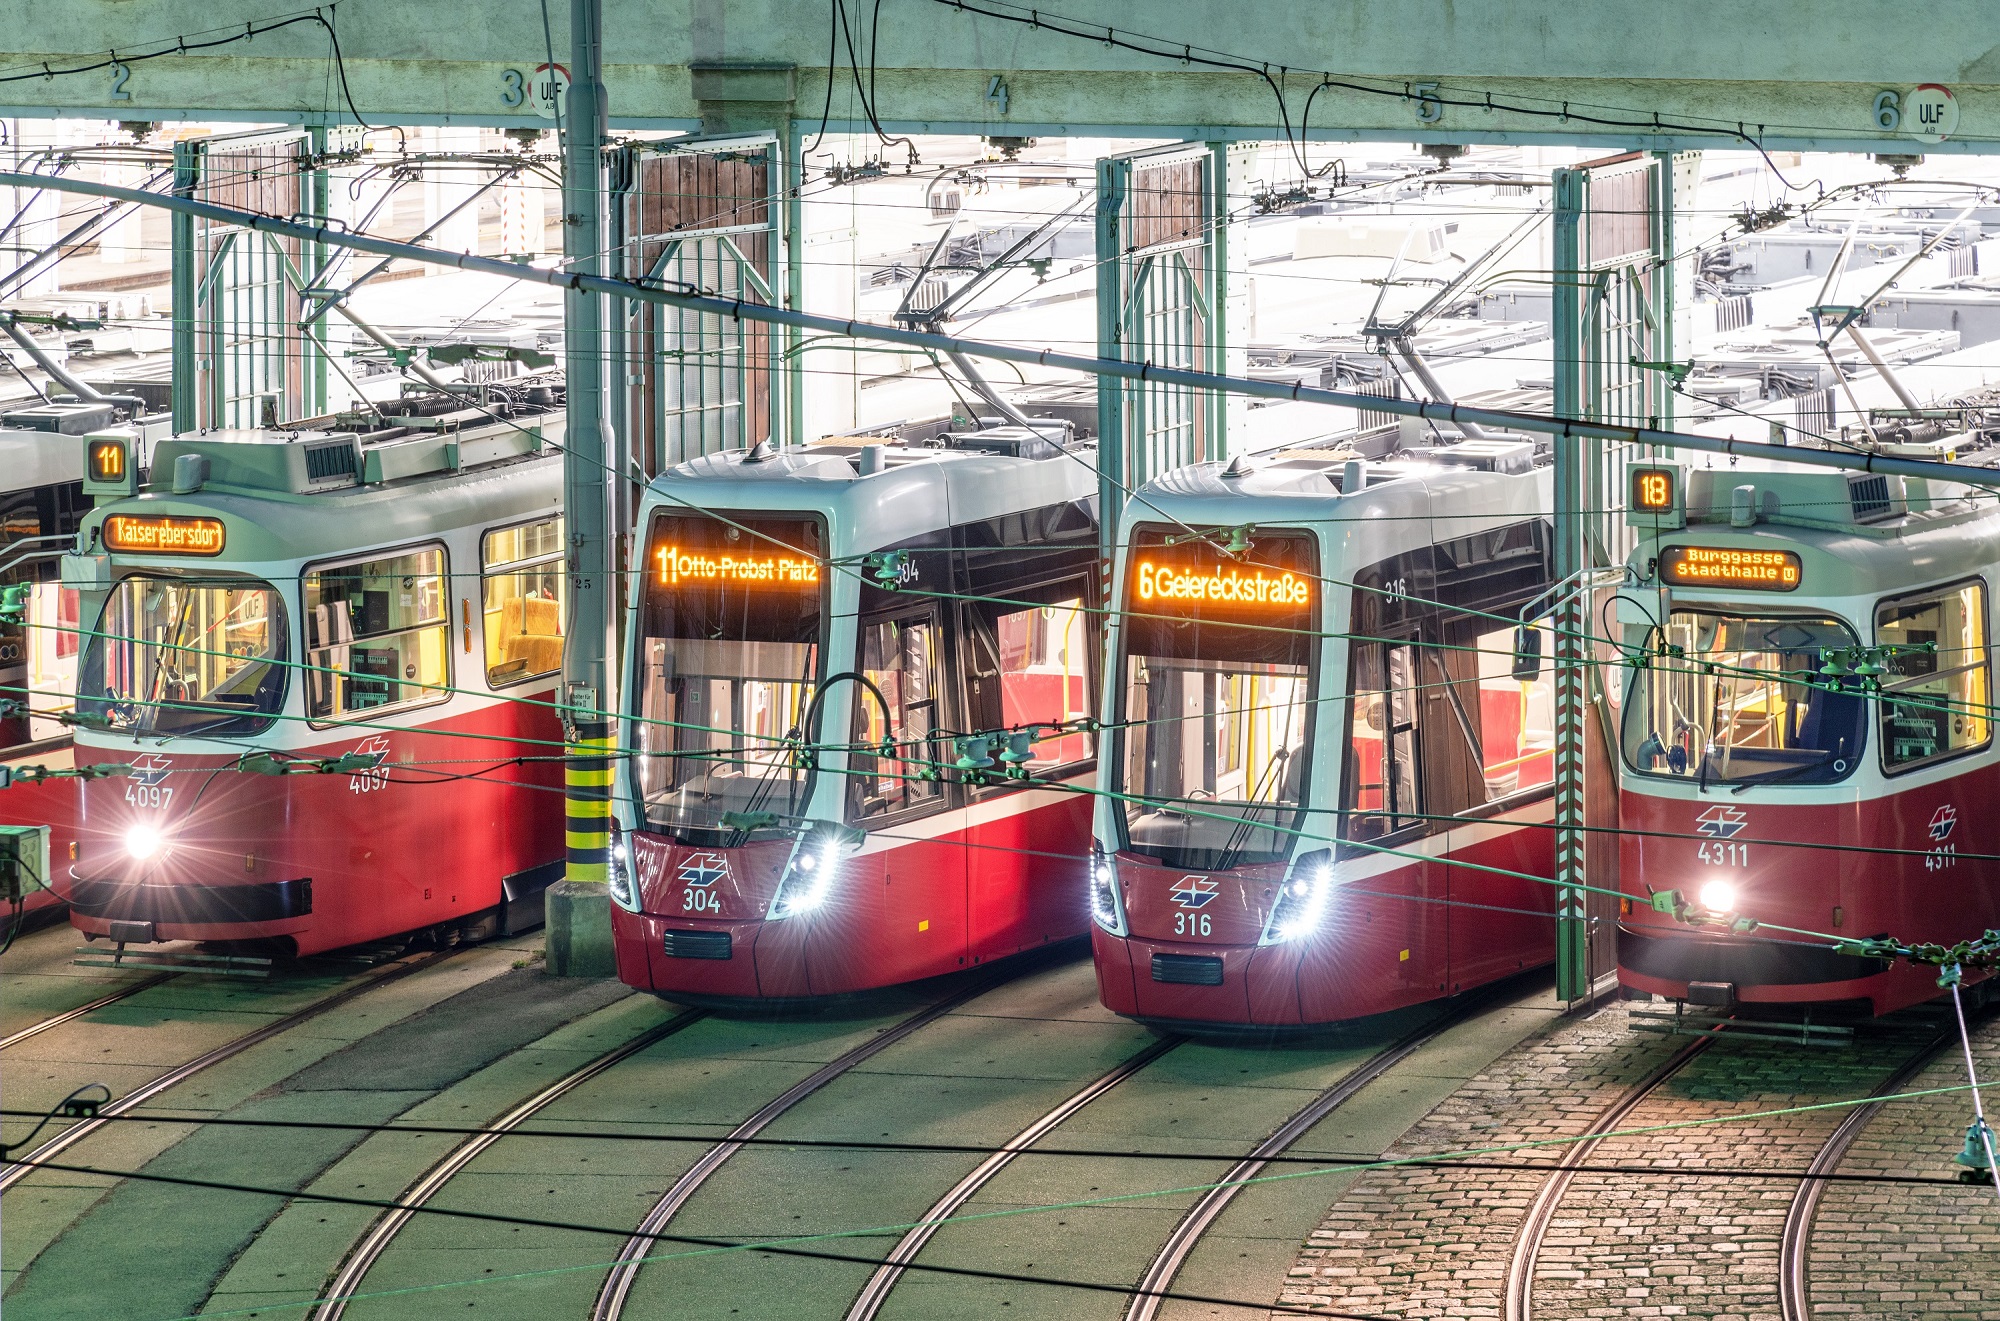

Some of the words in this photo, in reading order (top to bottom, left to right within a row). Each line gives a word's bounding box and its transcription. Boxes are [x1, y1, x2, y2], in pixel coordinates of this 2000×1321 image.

[109, 63, 130, 100] 2
[501, 69, 524, 108] 3
[541, 82, 562, 100] ULF
[986, 75, 1009, 114] 4
[1416, 82, 1442, 123] 5
[1873, 90, 1900, 131] 6
[1919, 104, 1944, 124] ULF
[98, 446, 119, 473] 11
[1641, 475, 1666, 505] 18
[117, 516, 223, 547] Kaiserebersdorf
[657, 547, 677, 583] 11
[677, 555, 817, 582] Otto-Probst-Platz
[1688, 549, 1784, 565] Burggasse
[576, 579, 591, 589] 25
[1139, 562, 1154, 599] 6
[1155, 566, 1307, 604] Geiereckstraße
[1677, 563, 1777, 579] Stadthalle
[1385, 578, 1406, 604] 316
[244, 599, 260, 620] ULF
[349, 767, 390, 795] 4097
[125, 785, 174, 810] 4097
[1698, 842, 1747, 867] 4311
[1926, 843, 1955, 872] 4311
[683, 888, 720, 914] 304
[1174, 912, 1211, 937] 316
